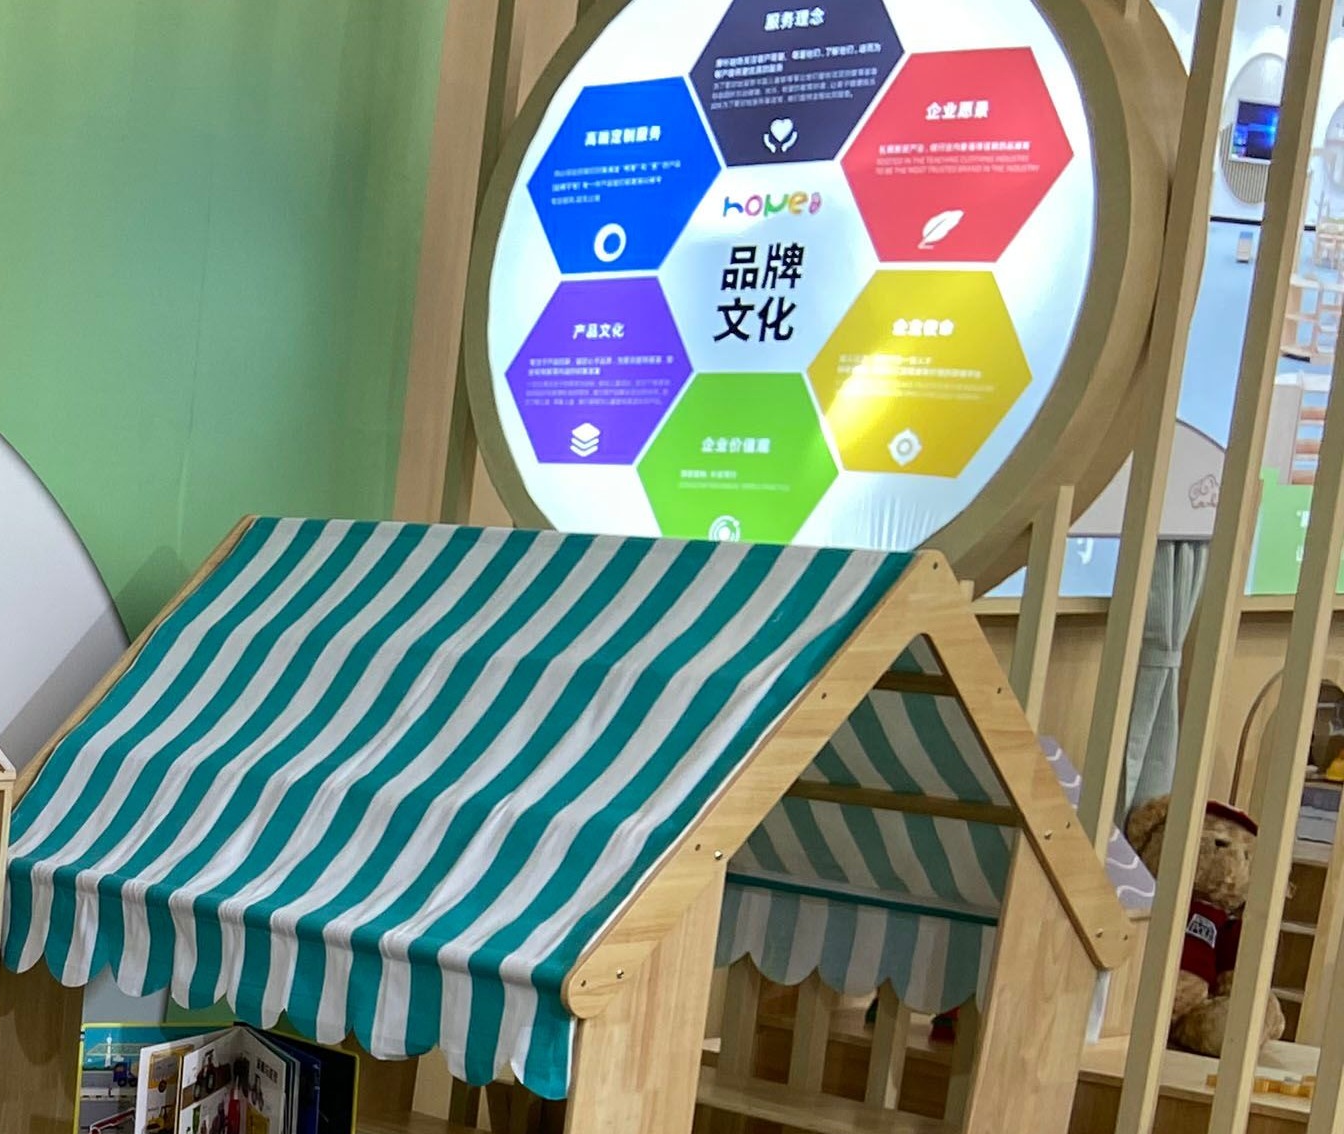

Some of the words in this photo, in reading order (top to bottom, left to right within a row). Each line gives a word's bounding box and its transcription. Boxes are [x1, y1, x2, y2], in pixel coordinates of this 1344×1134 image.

[764, 6, 825, 31] 服务理念
[925, 100, 989, 121] 企业愿景
[721, 242, 804, 291] 品牌
[572, 323, 624, 340] 产品文化
[713, 296, 797, 343] 文化
